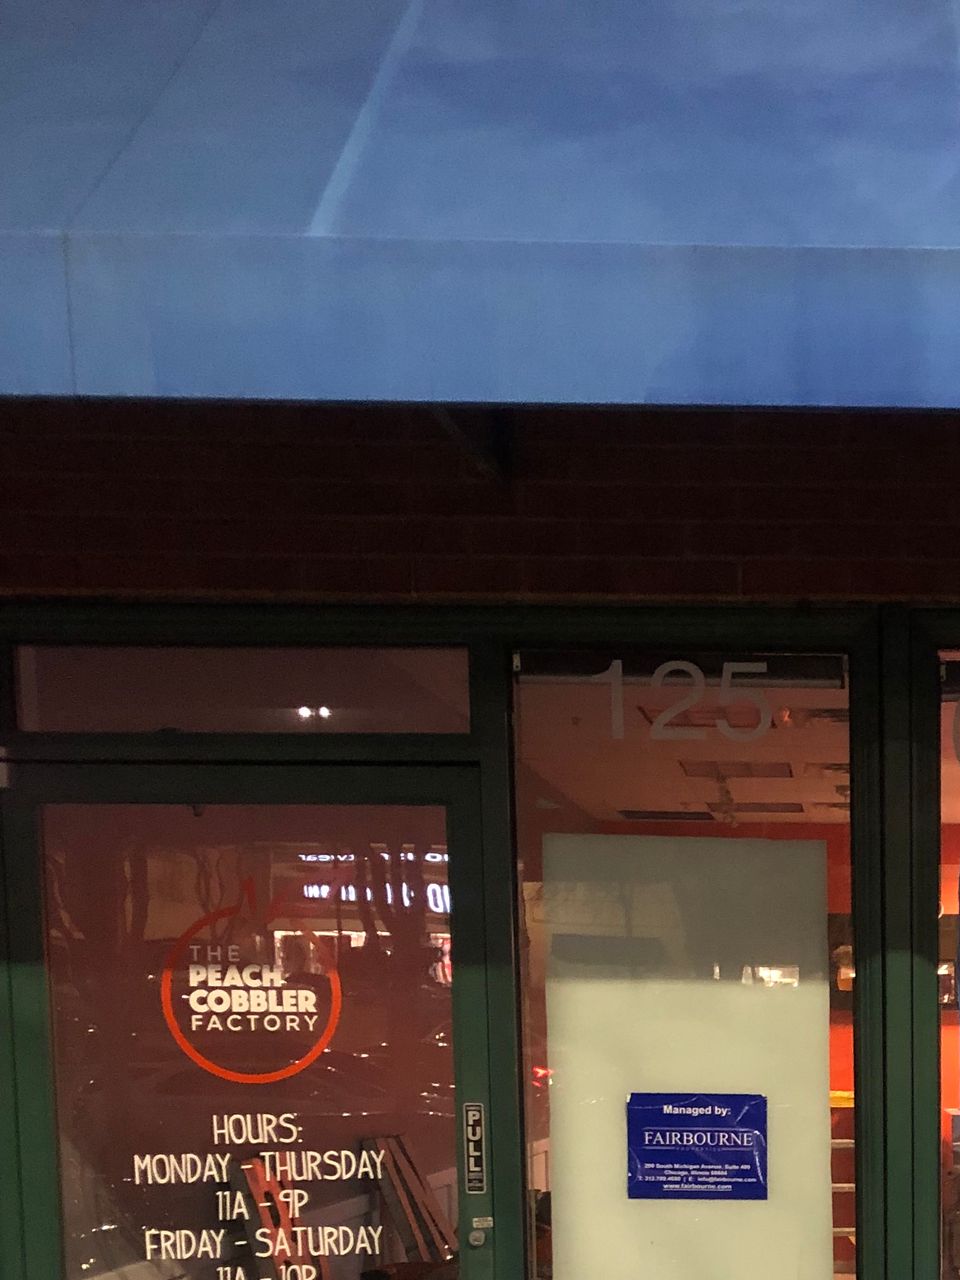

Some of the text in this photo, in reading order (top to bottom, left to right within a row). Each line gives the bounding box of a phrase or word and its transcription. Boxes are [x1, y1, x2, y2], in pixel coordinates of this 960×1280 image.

[592, 660, 772, 742] 125
[189, 944, 240, 961] THE
[188, 964, 282, 987] PEACH
[188, 989, 317, 1013] COBBLER
[191, 1014, 318, 1031] FACTORY
[663, 1105, 731, 1116] Managed by:
[212, 1113, 303, 1145] HOURS:
[467, 1110, 481, 1171] PULL
[643, 1131, 753, 1146] FAIRBOURNE
[133, 1153, 231, 1185] MONDAY
[259, 1149, 385, 1182] THURSDAY
[215, 1191, 250, 1220] 11A
[279, 1189, 309, 1218] 9P
[144, 1229, 225, 1260] FRIDAY
[254, 1225, 383, 1257] SATURDAY
